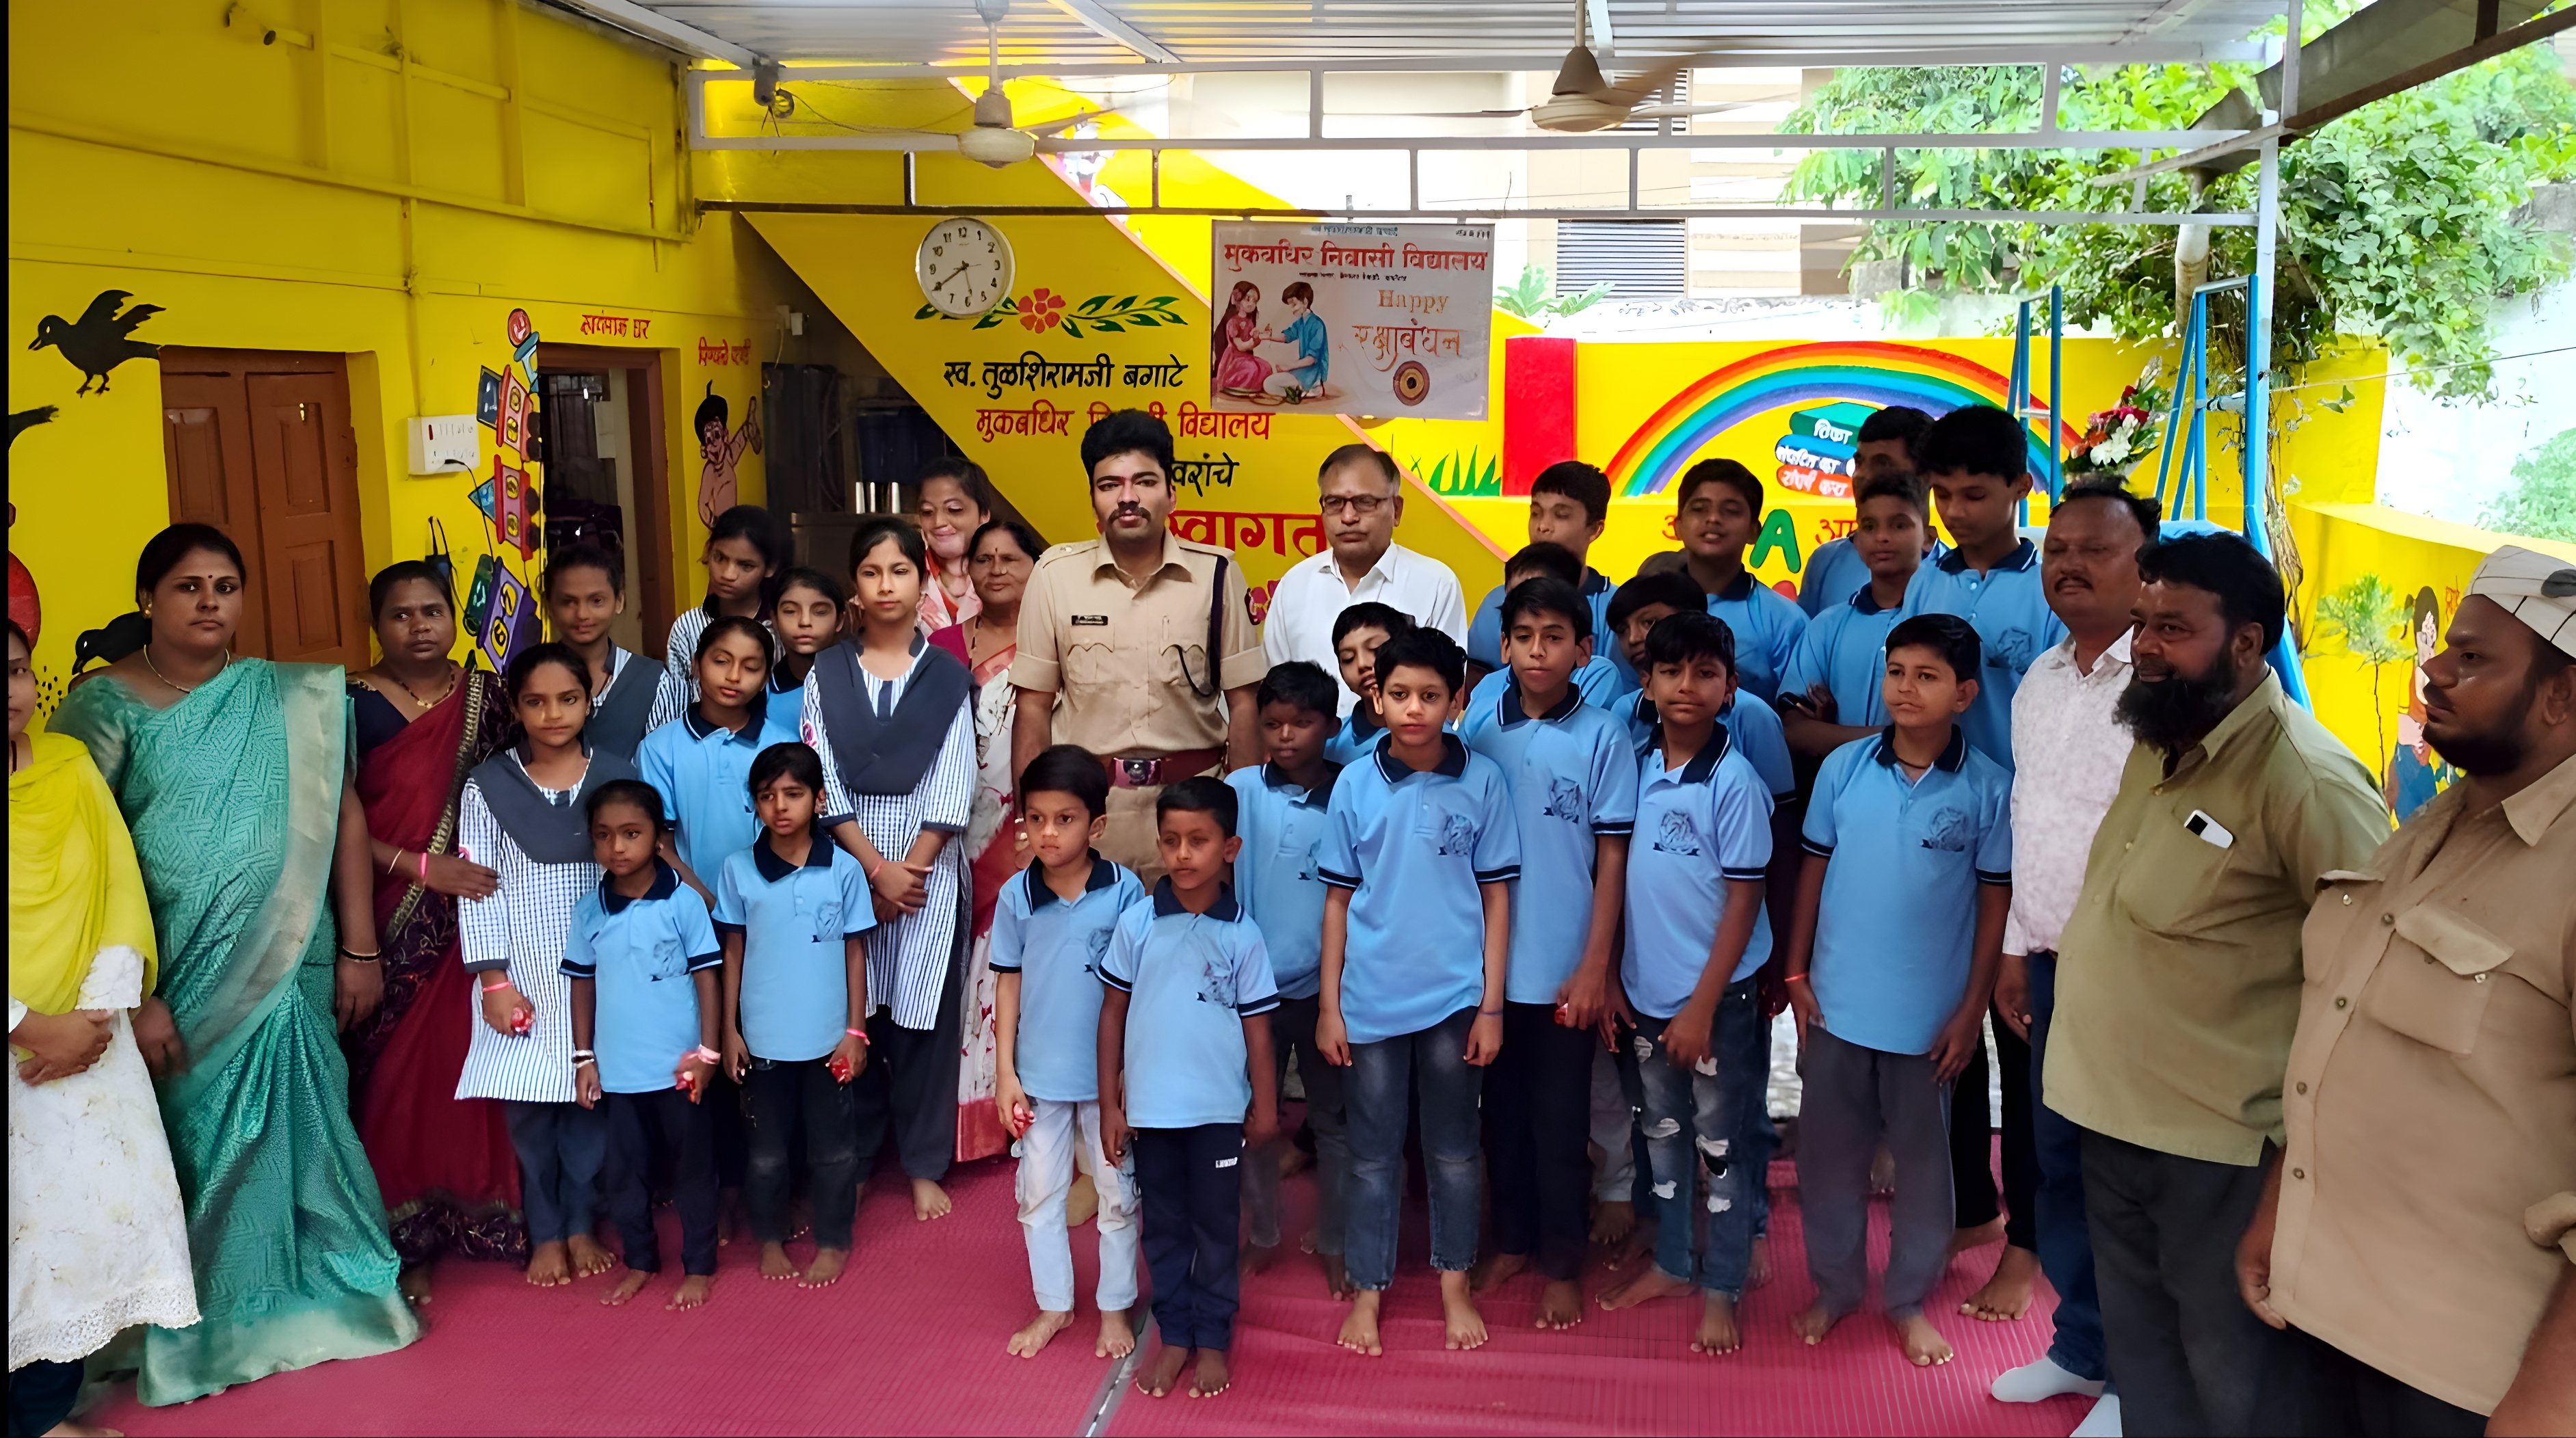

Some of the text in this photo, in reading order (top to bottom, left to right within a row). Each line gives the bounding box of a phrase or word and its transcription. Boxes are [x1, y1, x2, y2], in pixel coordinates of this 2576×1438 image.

[1320, 240, 1394, 269] निवासी
[1403, 242, 1488, 271] विद्यालय
[1378, 289, 1448, 314] Happy
[1352, 318, 1466, 372] रक्षाबंधन
[983, 350, 1115, 399] तुळशिरामजी
[1124, 354, 1188, 388] बगाटे
[976, 399, 1074, 442] मुकबधिर
[1178, 401, 1276, 440] विद्यालय
[1171, 452, 1240, 497] वरांचे
